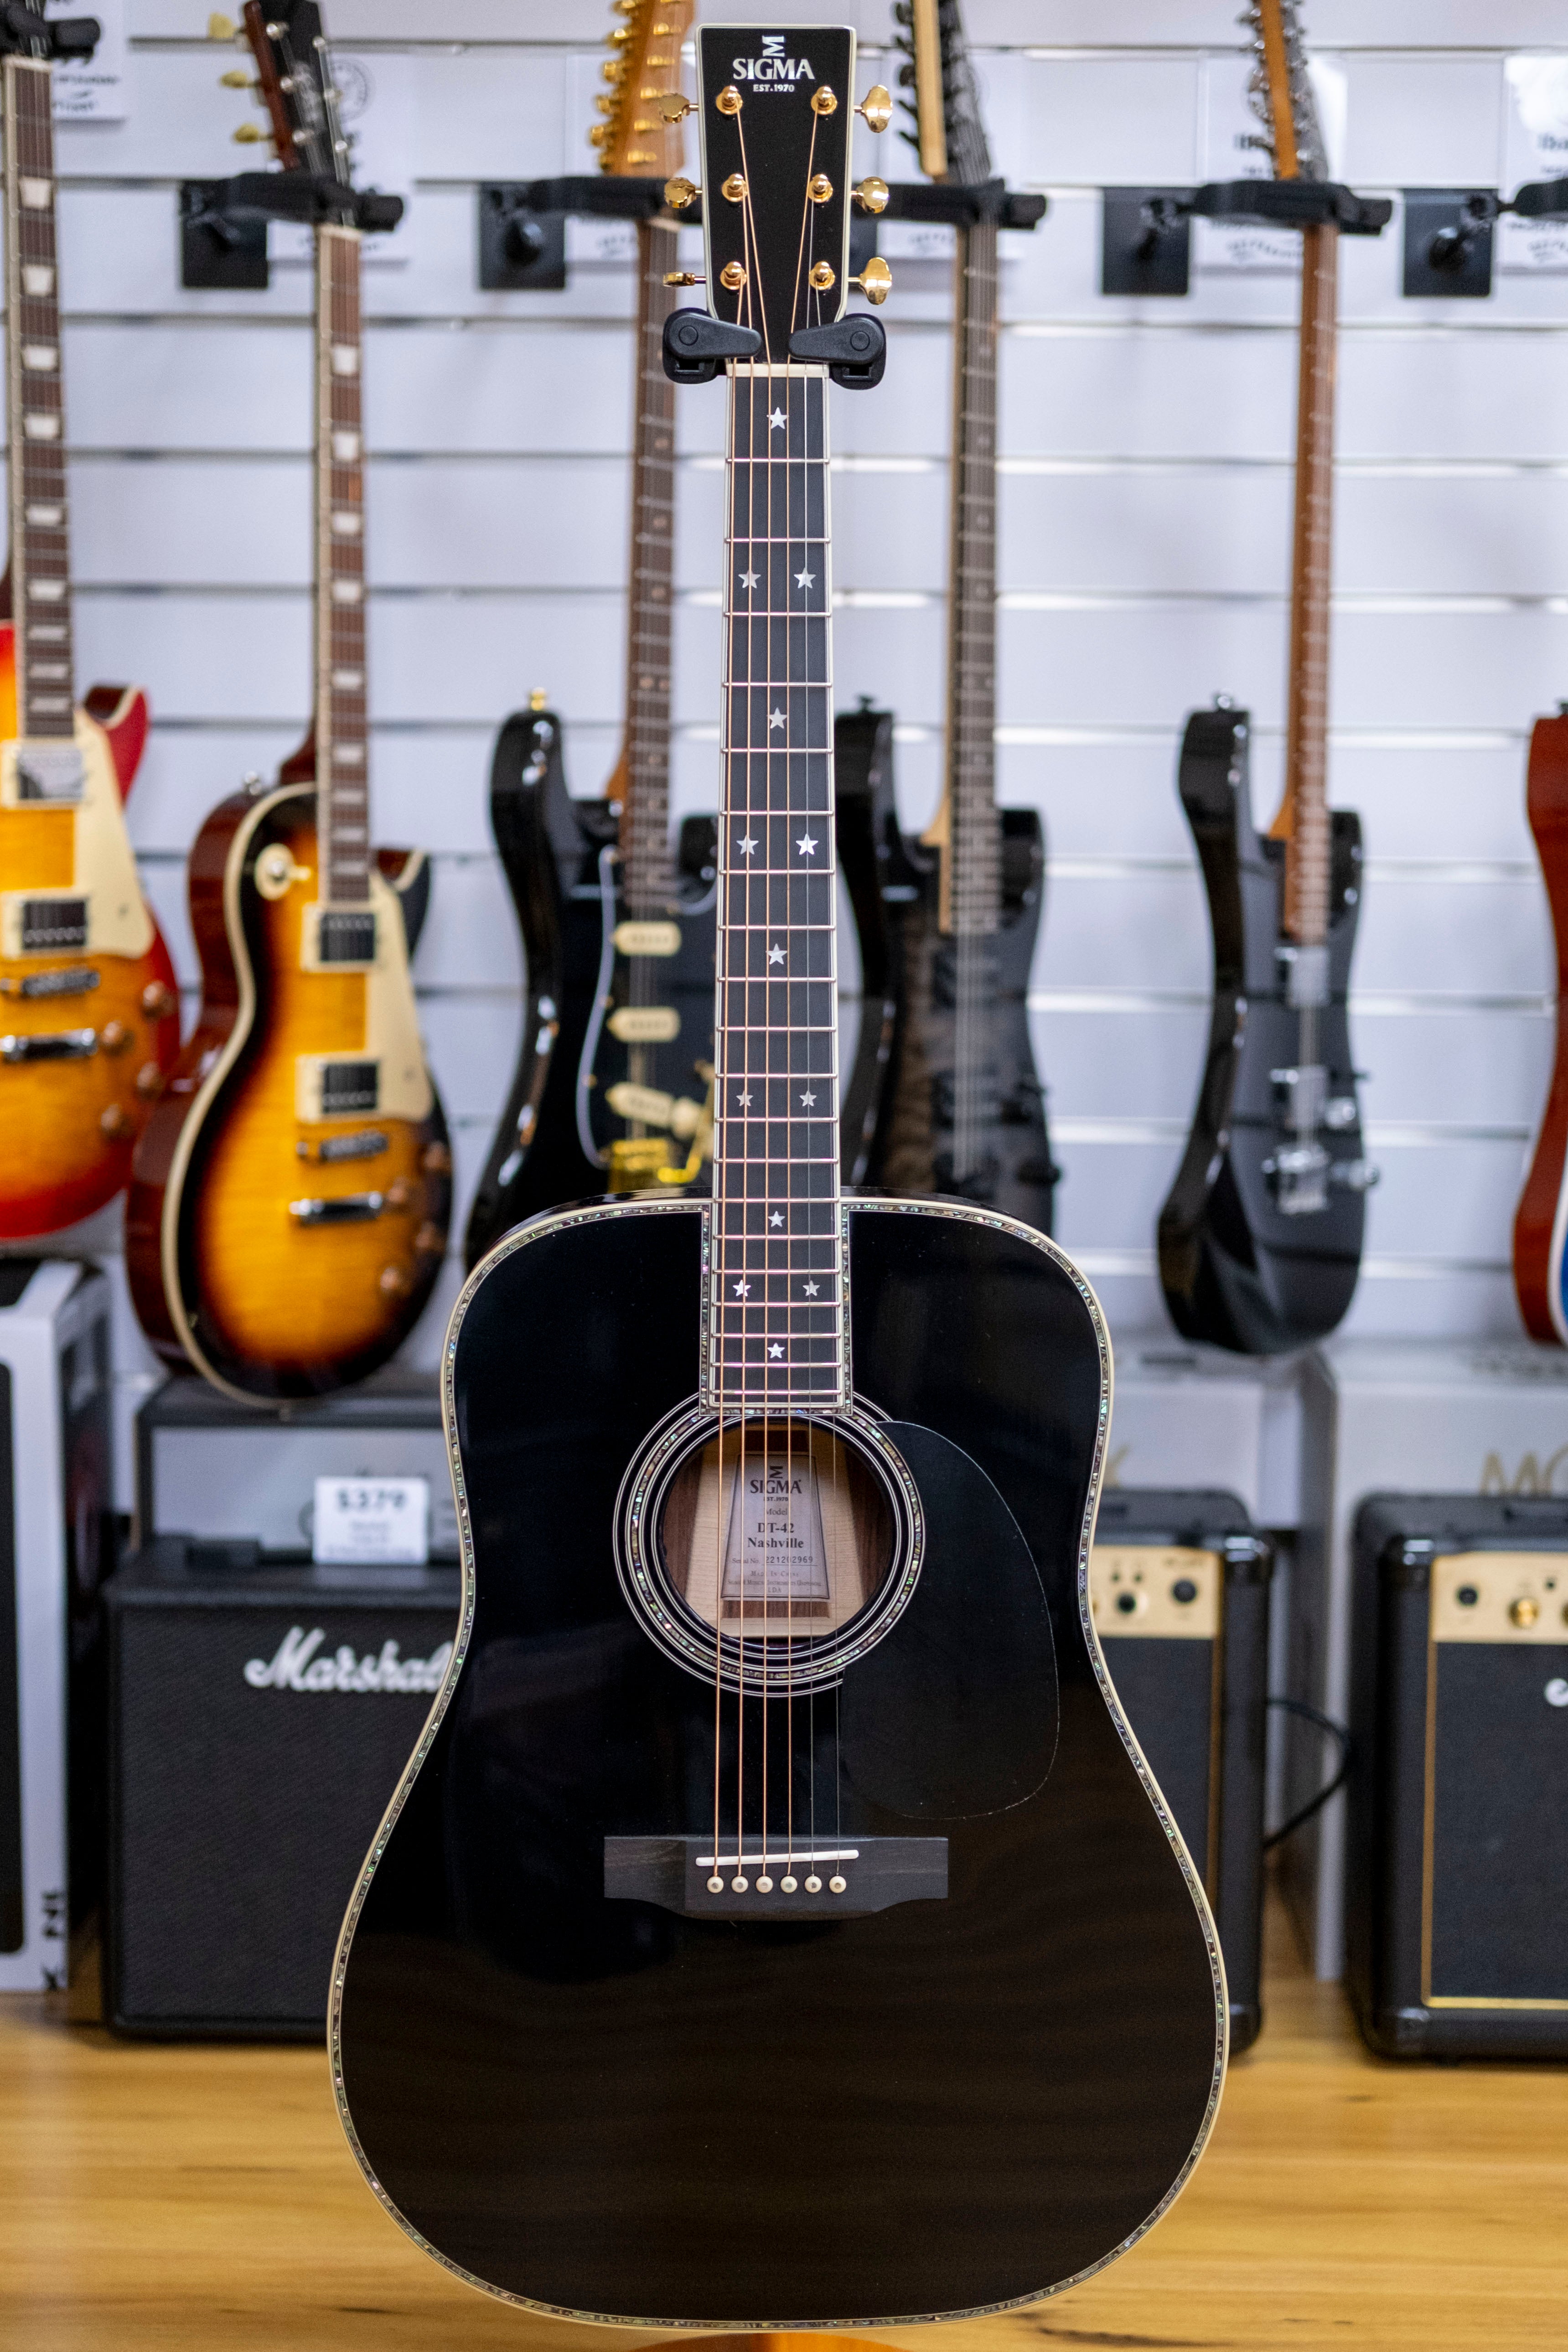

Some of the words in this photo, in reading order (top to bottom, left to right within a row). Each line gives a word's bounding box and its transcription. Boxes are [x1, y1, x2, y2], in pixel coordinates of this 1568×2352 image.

[733, 58, 815, 80] SIGMA
[753, 84, 795, 92] EST.1970
[750, 1479, 802, 1494] SIGMA
[757, 1522, 795, 1533] DT-42
[747, 1537, 804, 1548] Nashville
[245, 1626, 455, 1692] Marshal
